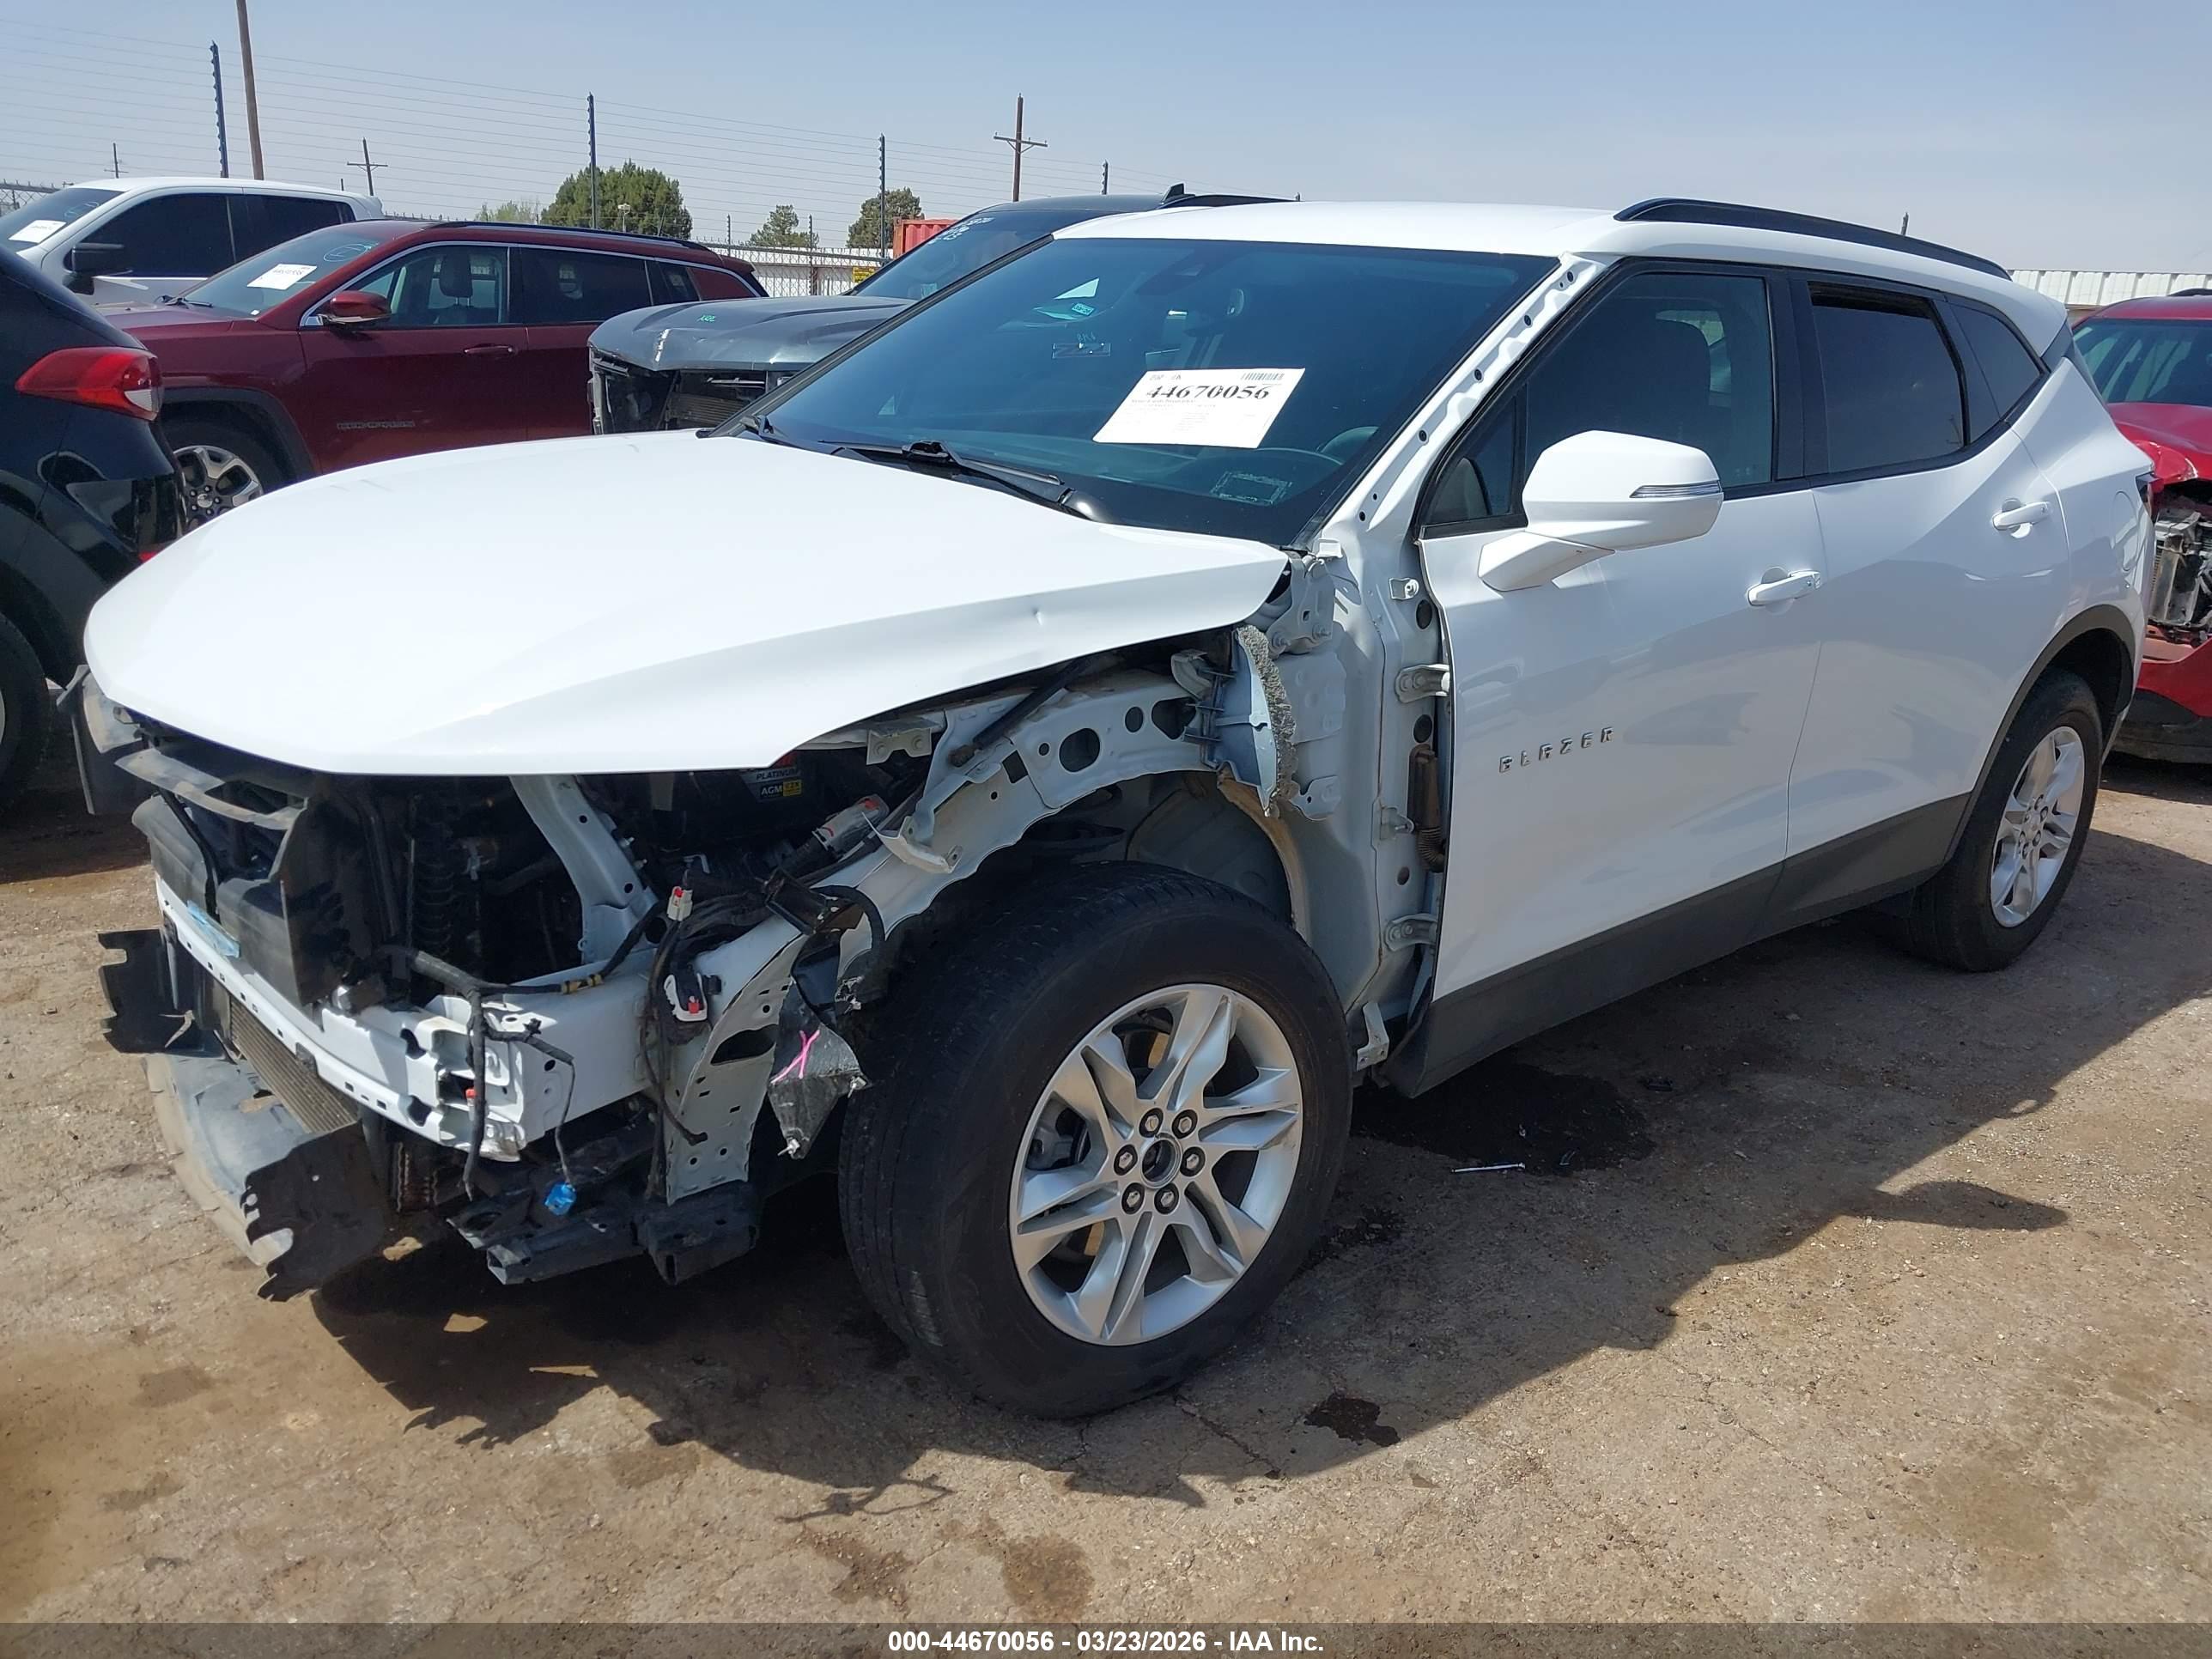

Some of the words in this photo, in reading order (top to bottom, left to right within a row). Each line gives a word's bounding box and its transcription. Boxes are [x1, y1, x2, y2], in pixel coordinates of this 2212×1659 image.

[1146, 385, 1273, 399] 44670056
[1498, 726, 1615, 774] BLAZER
[761, 784, 783, 796] AGM
